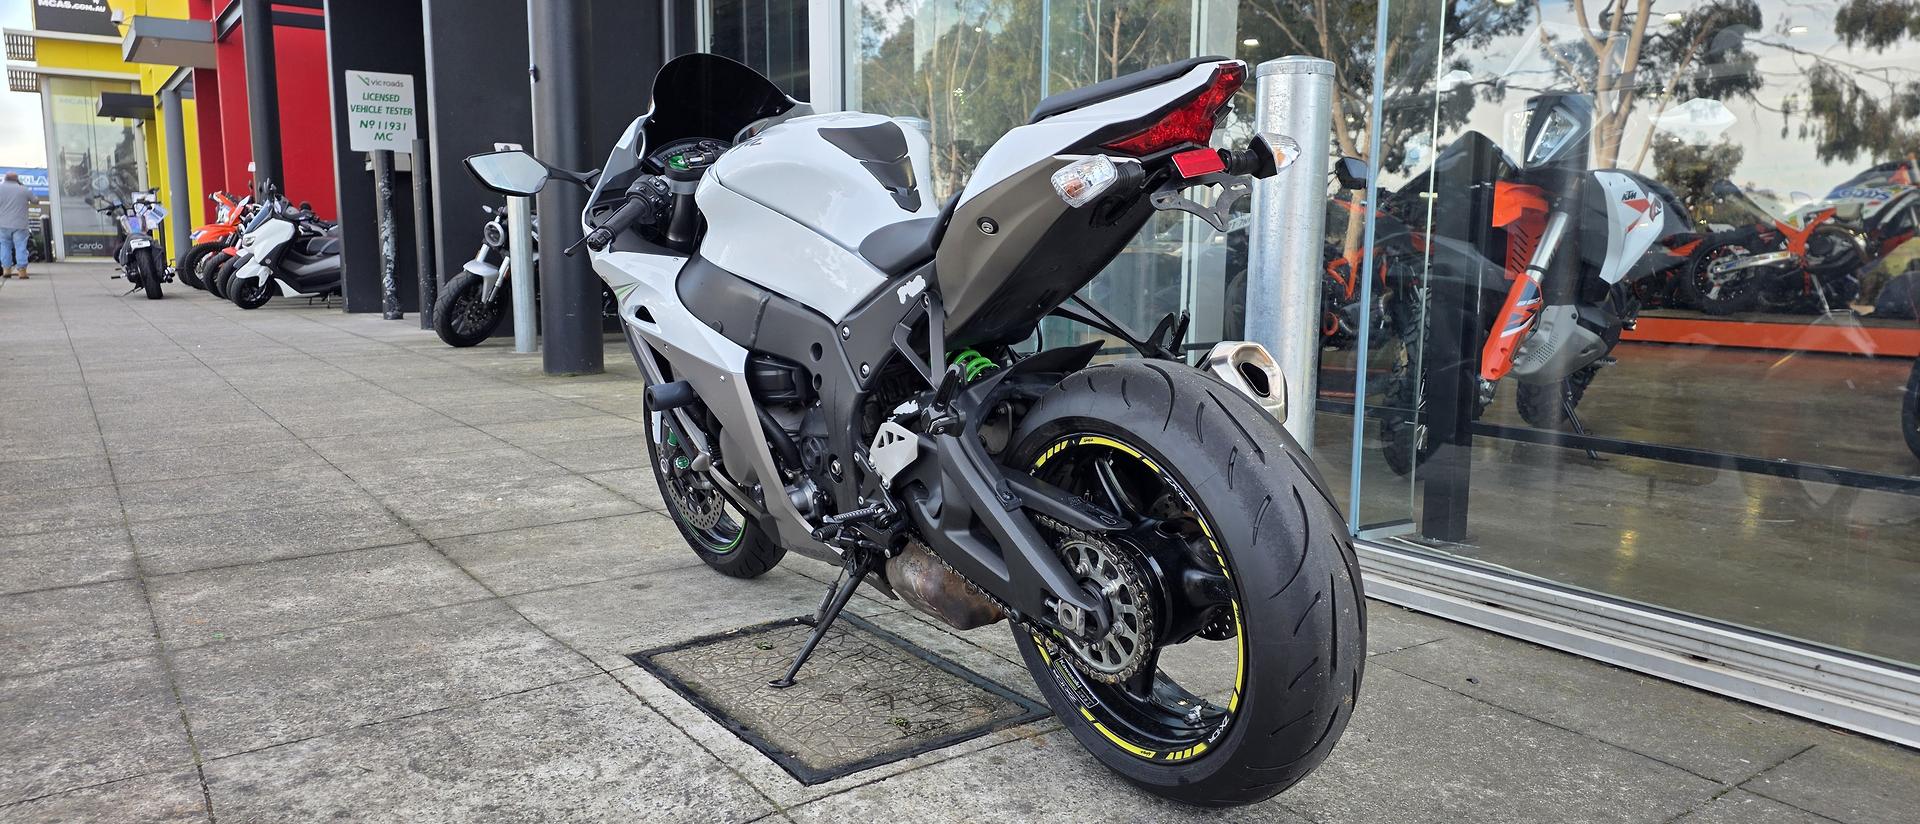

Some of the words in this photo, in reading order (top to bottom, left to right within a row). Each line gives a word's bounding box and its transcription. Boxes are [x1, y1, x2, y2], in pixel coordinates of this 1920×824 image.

[363, 92, 400, 102] LICENSED
[351, 104, 382, 114] VEHICLE
[386, 106, 413, 116] TESTER
[378, 121, 406, 131] 11931
[374, 132, 393, 141] MC
[1622, 190, 1637, 201] KTM
[79, 241, 103, 249] cardo
[1059, 659, 1082, 689] Kawasaki
